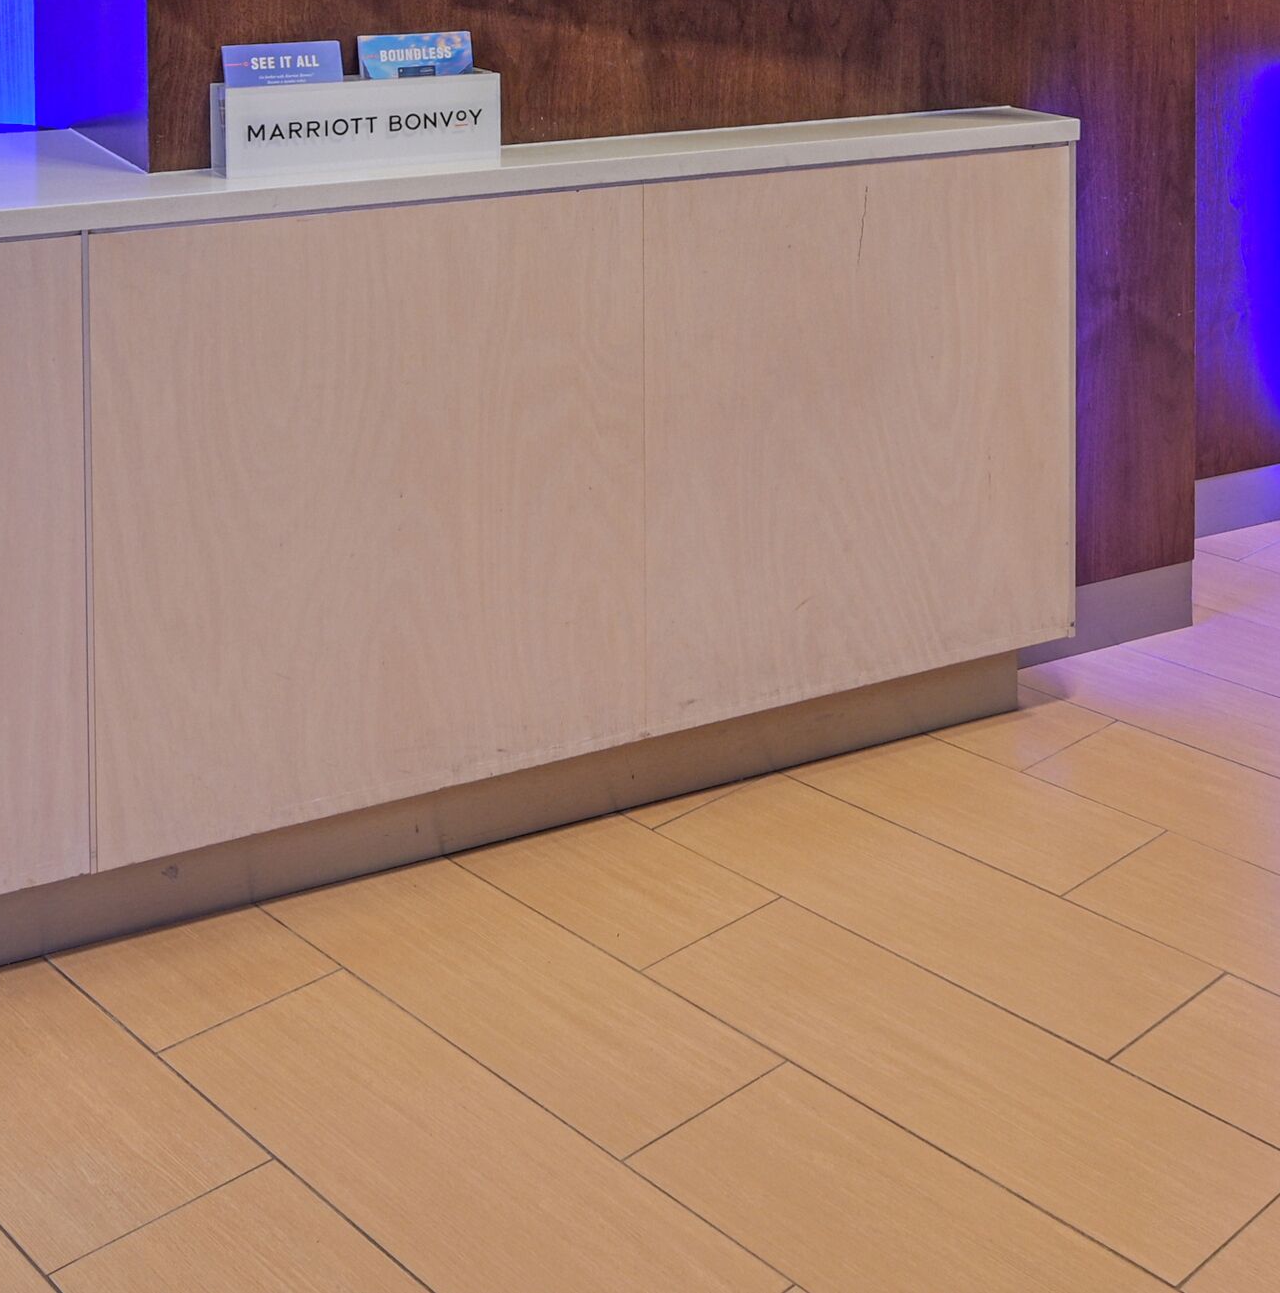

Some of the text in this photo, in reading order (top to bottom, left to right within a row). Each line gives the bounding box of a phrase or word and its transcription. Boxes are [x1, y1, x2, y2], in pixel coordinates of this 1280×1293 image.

[251, 54, 320, 70] SEE IT ALL
[380, 46, 452, 62] BOUNDLESS
[248, 108, 483, 142] MARRIOTT BONVOY
